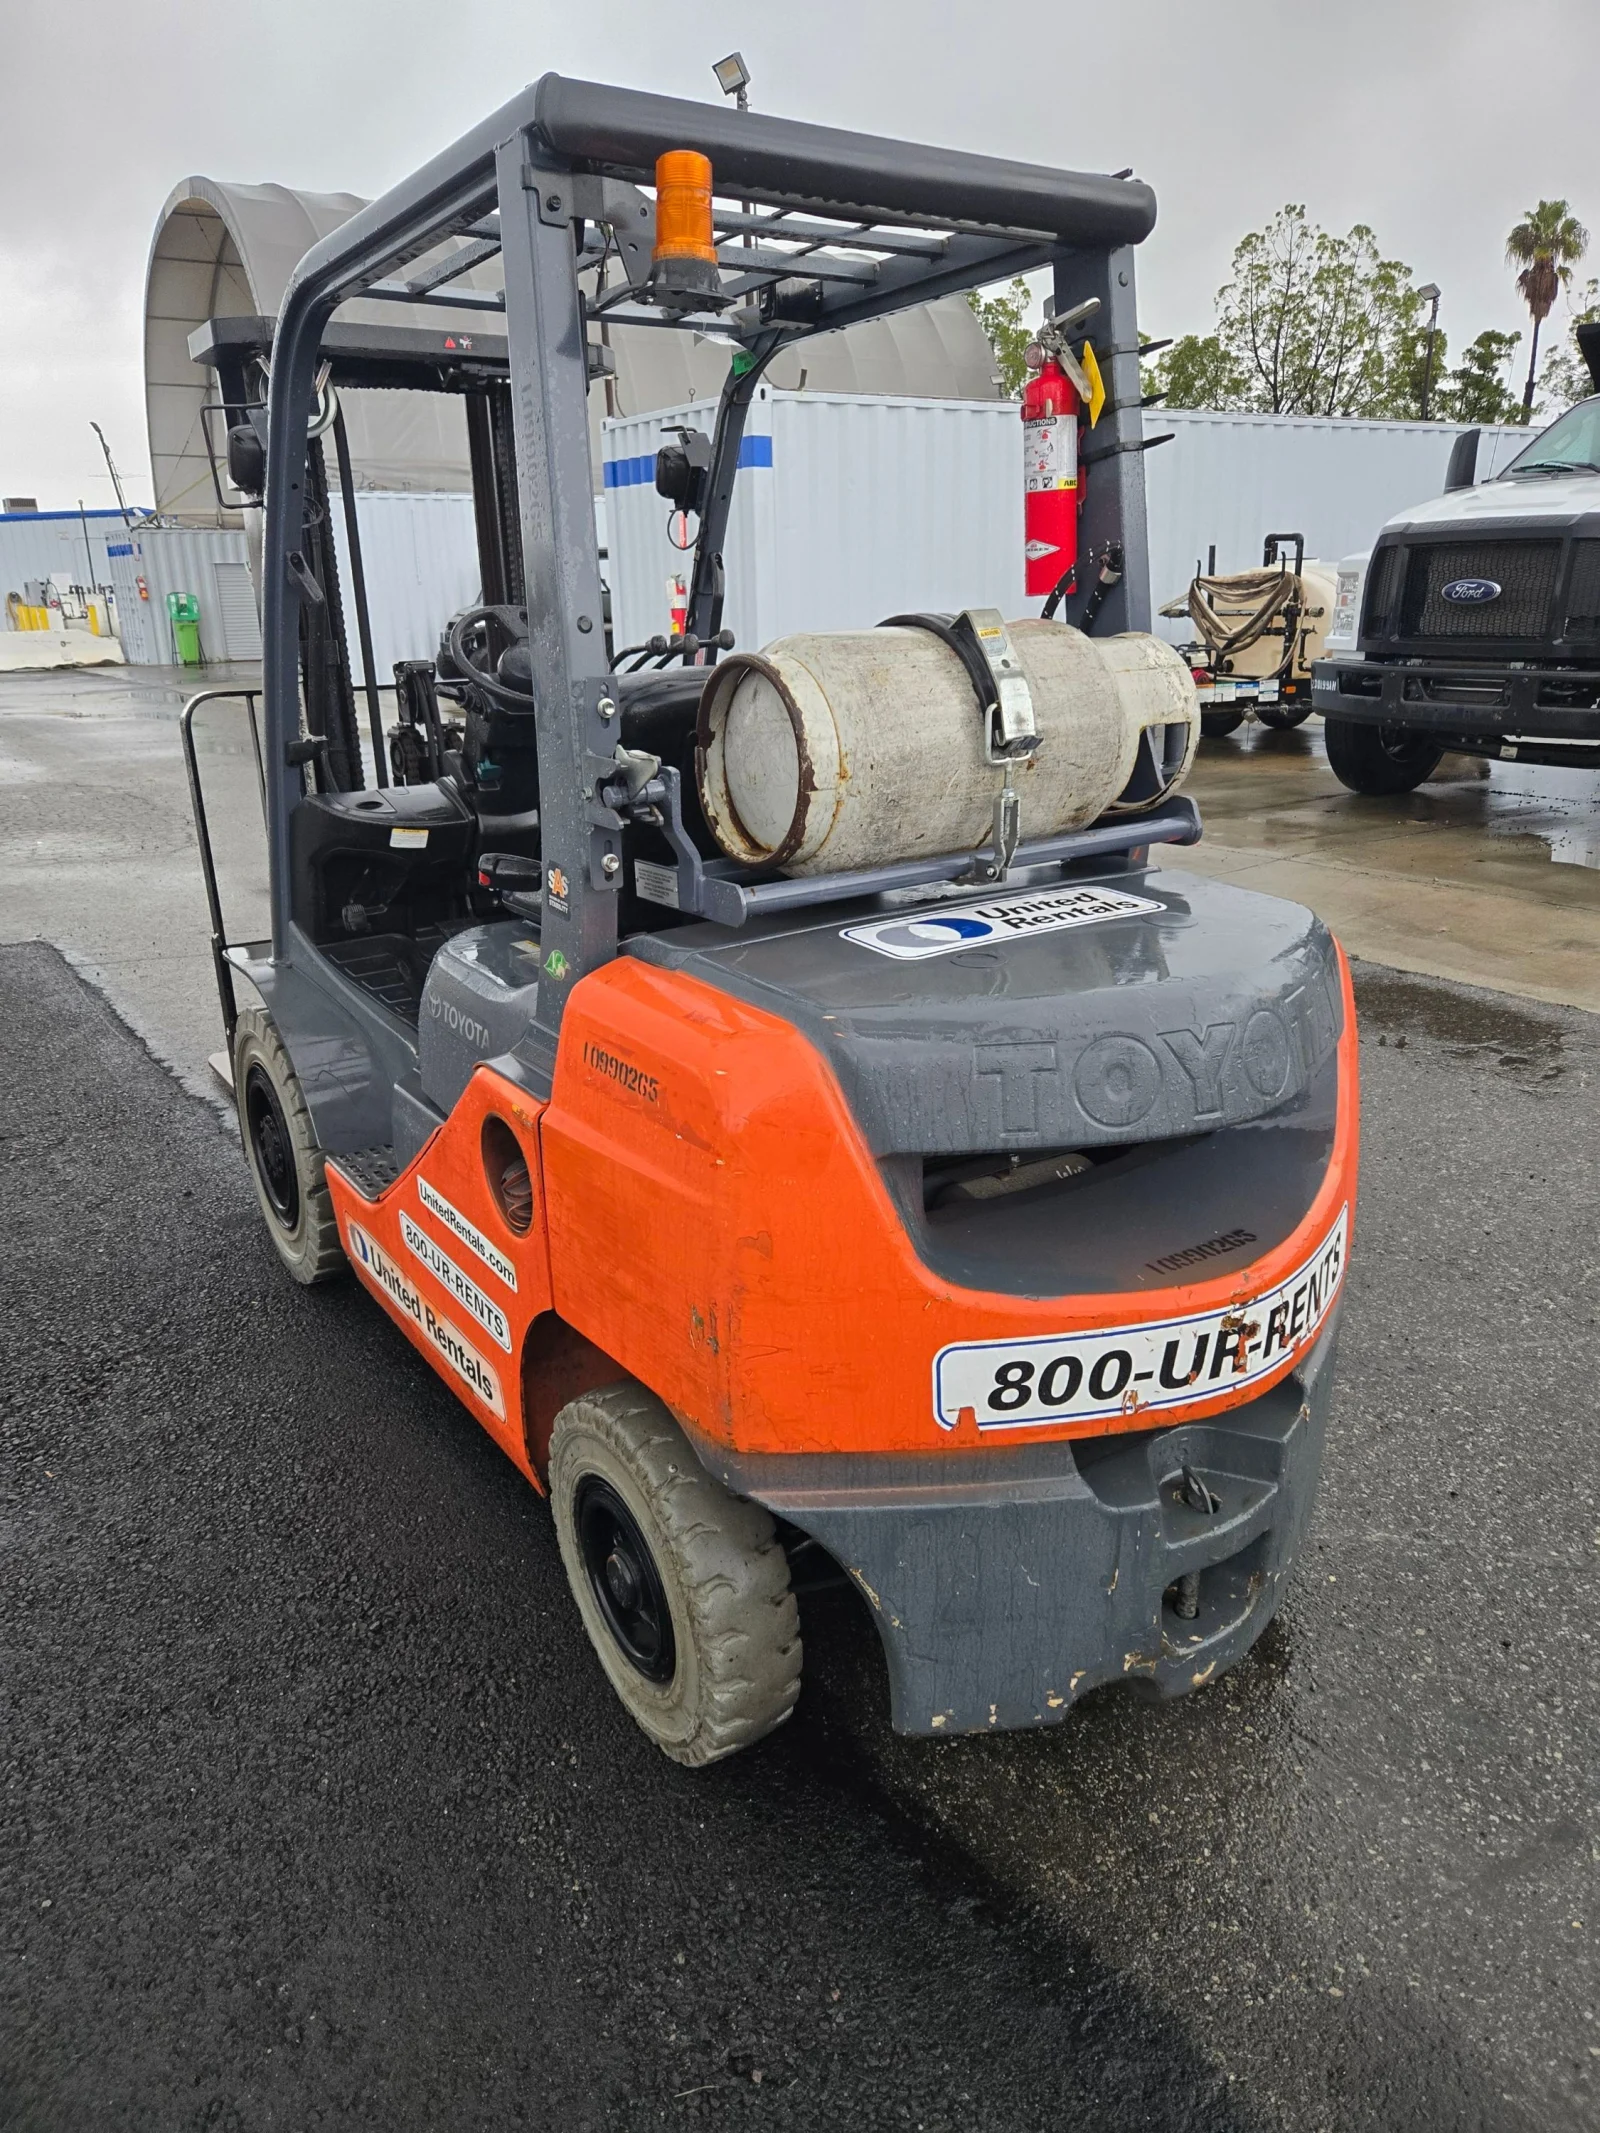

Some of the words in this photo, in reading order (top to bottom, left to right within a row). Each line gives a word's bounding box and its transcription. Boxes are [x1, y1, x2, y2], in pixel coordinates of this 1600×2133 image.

[1417, 519, 1490, 531] SUPER
[1451, 583, 1485, 599] Ford
[548, 867, 570, 899] SAS
[974, 893, 1100, 920] United
[1001, 900, 1140, 930] Rentals
[443, 1000, 491, 1049] TOYOTA
[419, 1182, 516, 1287] UnitedRentals.com
[406, 1224, 504, 1338] 800-UR-RENTS
[369, 1245, 422, 1321] United
[425, 1303, 494, 1401] Rentals
[987, 1231, 1342, 1412] 800-UR-RENTS
